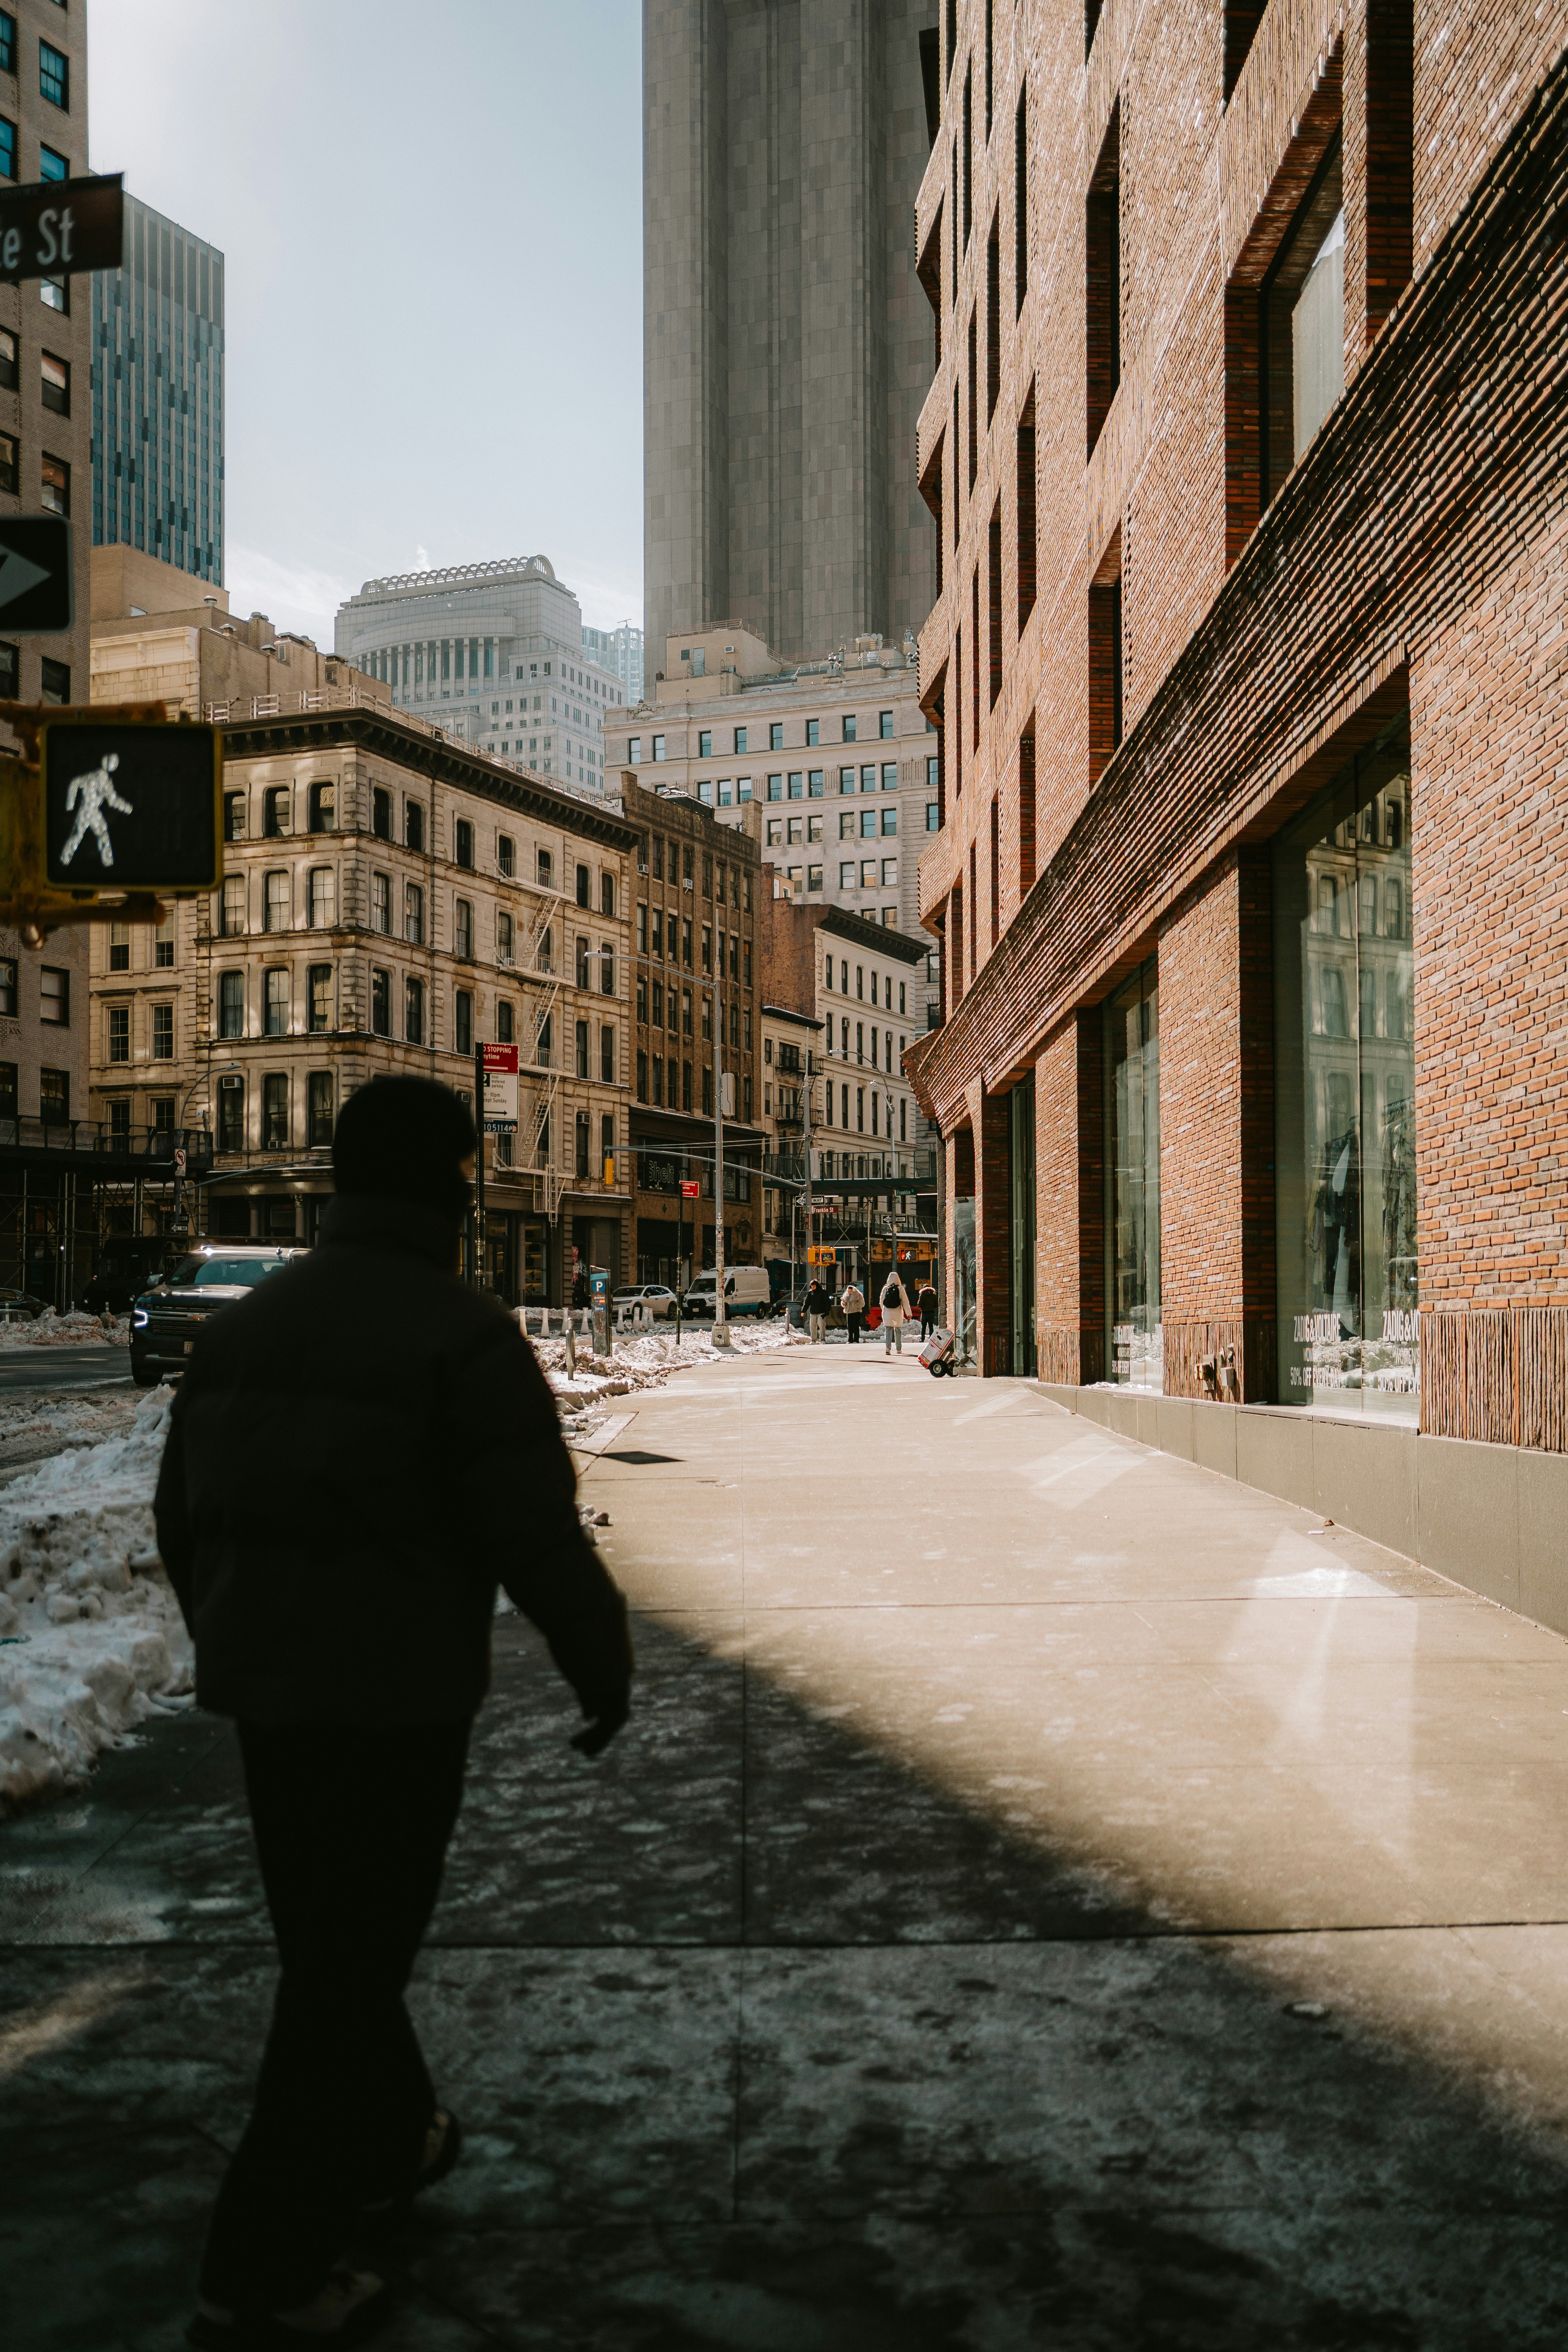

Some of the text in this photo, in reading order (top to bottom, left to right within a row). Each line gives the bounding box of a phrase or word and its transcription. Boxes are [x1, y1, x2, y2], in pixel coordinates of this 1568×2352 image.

[36, 206, 75, 266] St
[484, 1123, 508, 1132] 105114
[596, 1281, 603, 1292] P
[1294, 1313, 1341, 1342] ZADIG&VOLTAIRE
[1290, 1367, 1302, 1386] 50%
[1303, 1367, 1312, 1387] OFF
[1312, 1367, 1329, 1387] EVERY
